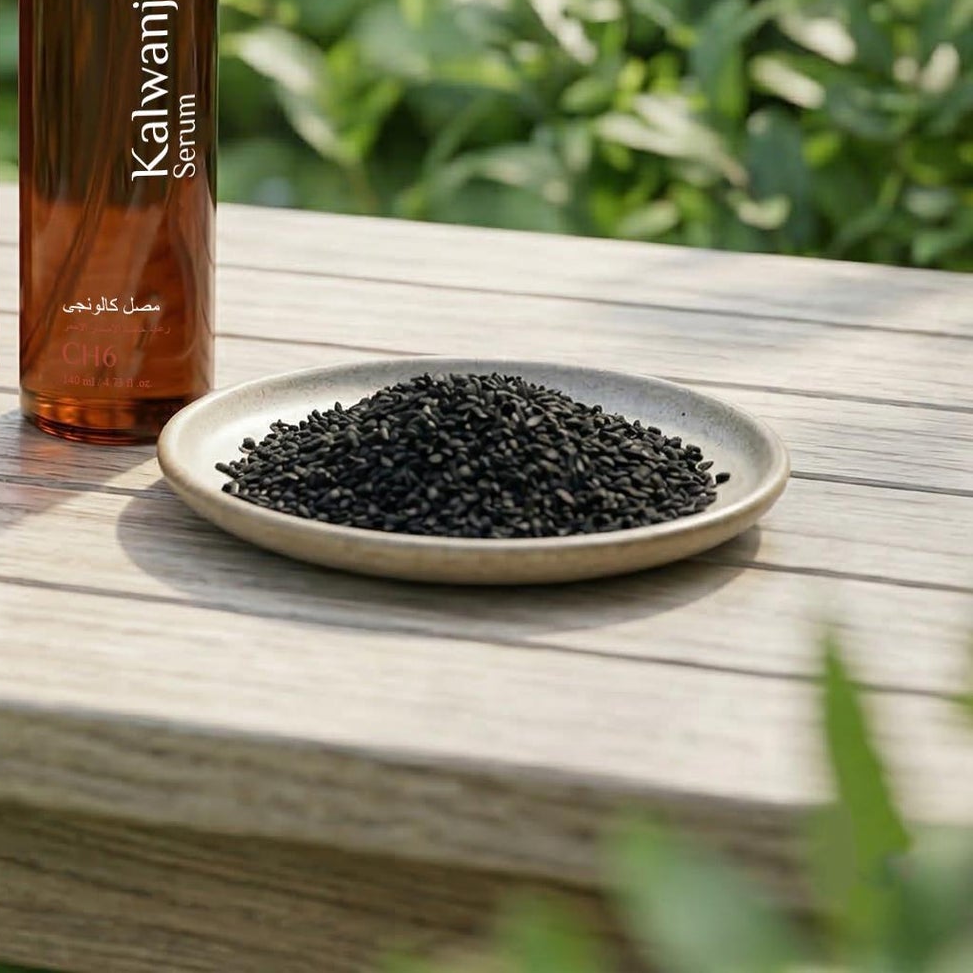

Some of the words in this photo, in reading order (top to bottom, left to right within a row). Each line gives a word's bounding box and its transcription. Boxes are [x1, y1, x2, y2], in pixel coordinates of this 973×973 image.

[173, 93, 196, 178] Serum
[122, 296, 161, 315] مصل
[62, 341, 117, 368] CH6
